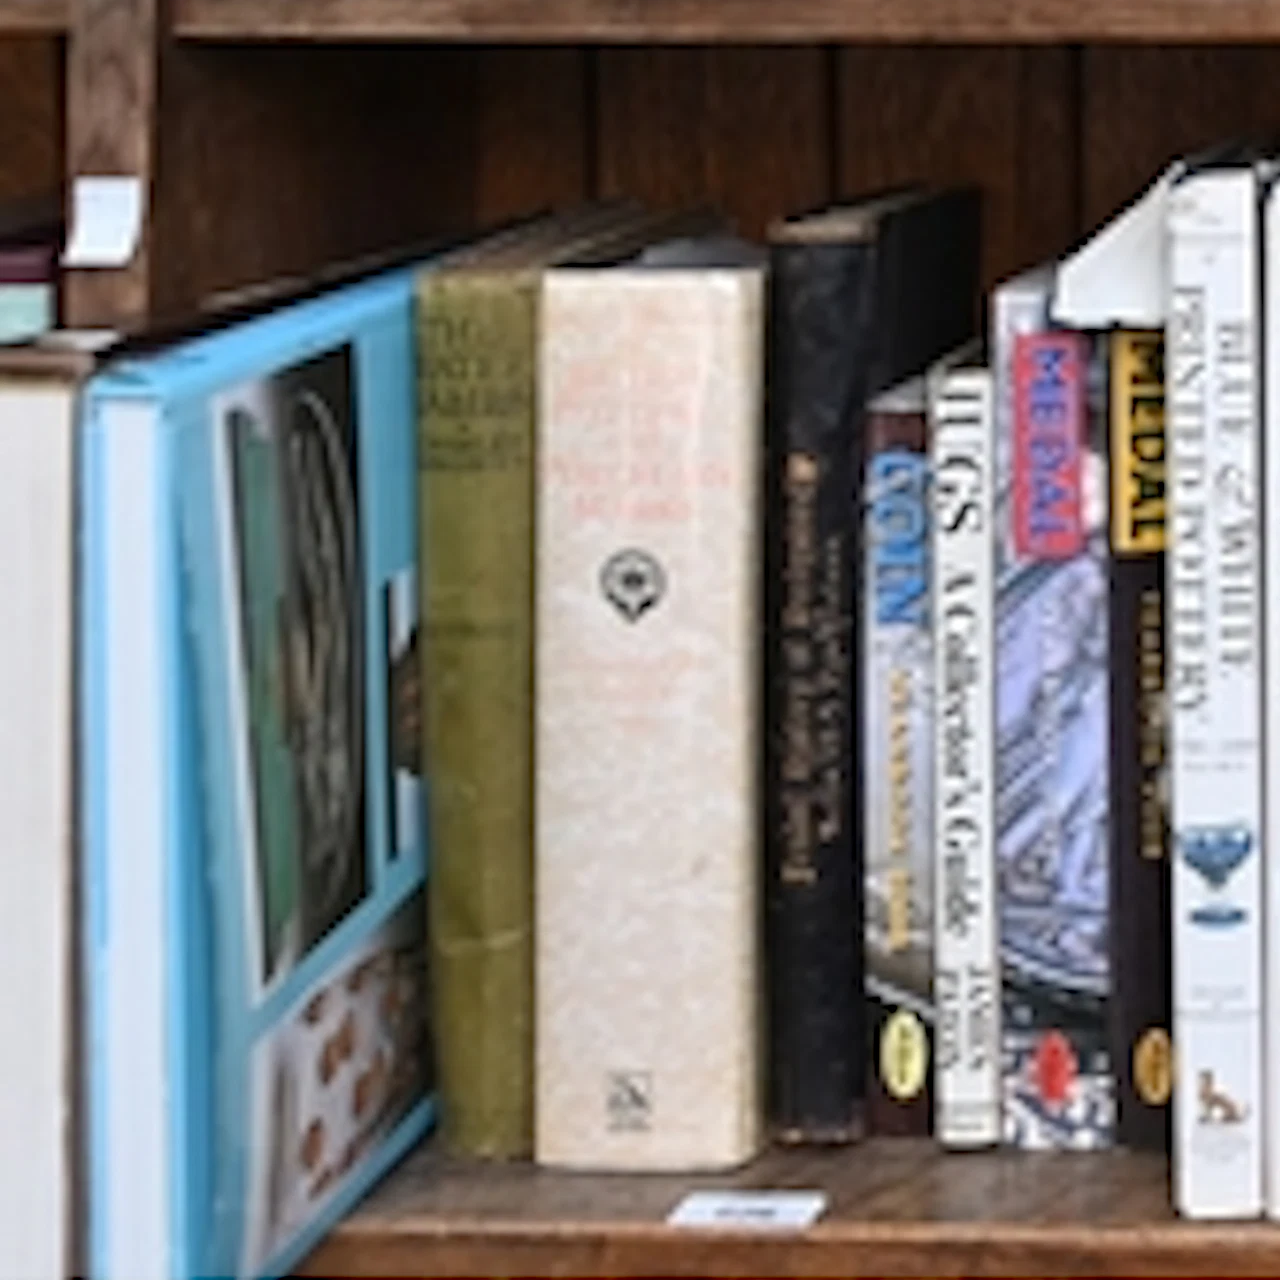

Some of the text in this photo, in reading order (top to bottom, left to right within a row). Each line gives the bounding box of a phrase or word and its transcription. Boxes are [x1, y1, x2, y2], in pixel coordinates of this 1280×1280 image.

[872, 452, 926, 624] COIN
[1028, 345, 1071, 541] MEDAL
[1130, 334, 1166, 541] MEDAL
[1172, 285, 1209, 726] PRINTED POTTERY
[1214, 320, 1252, 680] BLUE & WHITE
[943, 601, 982, 808] Collector's
[943, 817, 982, 939] Guide
